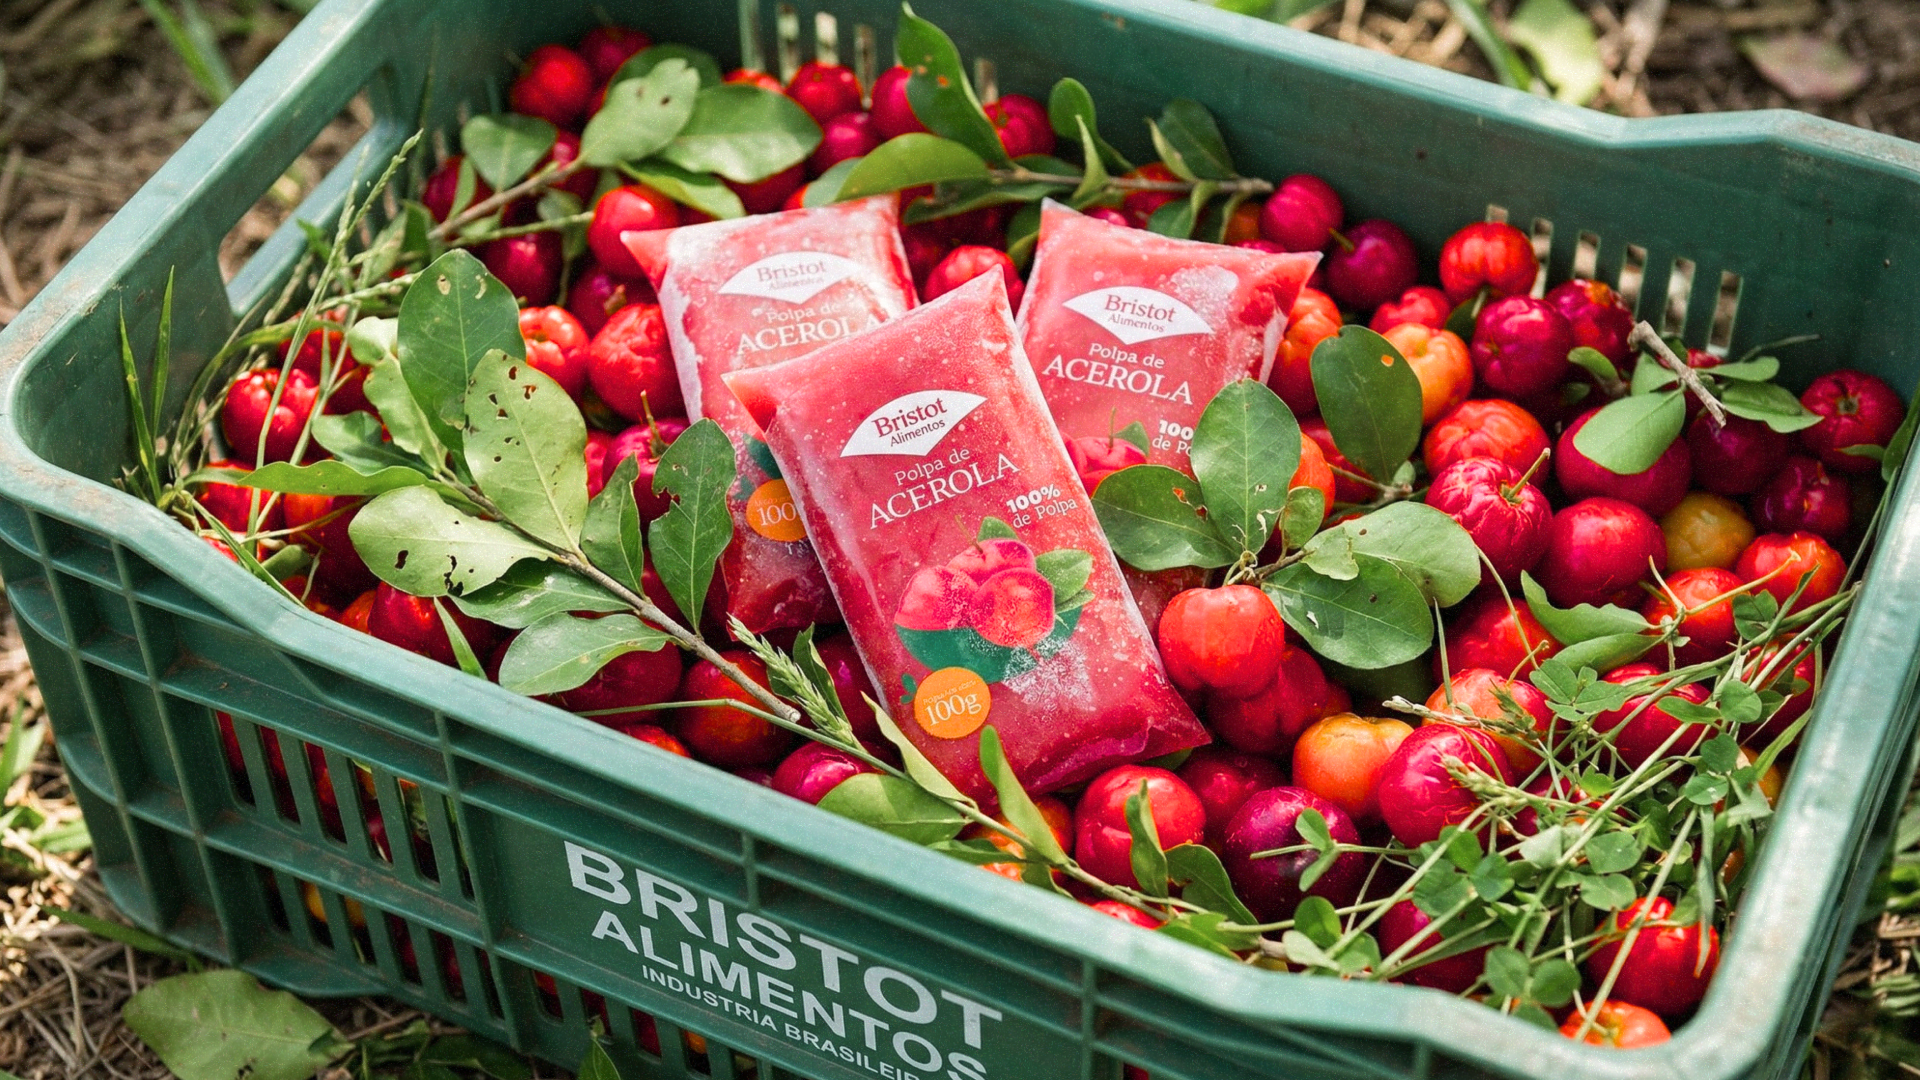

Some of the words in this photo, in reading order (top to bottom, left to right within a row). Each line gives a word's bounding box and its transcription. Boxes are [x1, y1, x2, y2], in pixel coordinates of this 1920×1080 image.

[757, 260, 827, 282] Bristot
[766, 307, 816, 323] Polpa
[1104, 294, 1177, 323] Bristot
[1107, 314, 1165, 333] Alimentos
[1088, 343, 1138, 364] Polpa
[1142, 353, 1165, 369] de
[1042, 354, 1194, 405] ACEROLA
[871, 397, 947, 438] Bristot
[1159, 419, 1194, 440] 100
[890, 419, 946, 447] Alimentos
[1151, 435, 1171, 451] de
[894, 457, 945, 486] Polpa
[948, 448, 971, 464] de
[870, 453, 1020, 530] ACEROLA
[1006, 483, 1061, 513] 100%
[756, 502, 798, 526] 100
[1012, 512, 1032, 529] de
[1035, 498, 1078, 520] Polpa
[925, 693, 982, 726] 100g
[564, 840, 1003, 1050] BRISTOT
[592, 910, 987, 1080] ALIMENTOS
[642, 964, 778, 1033] INDUSTRIA
